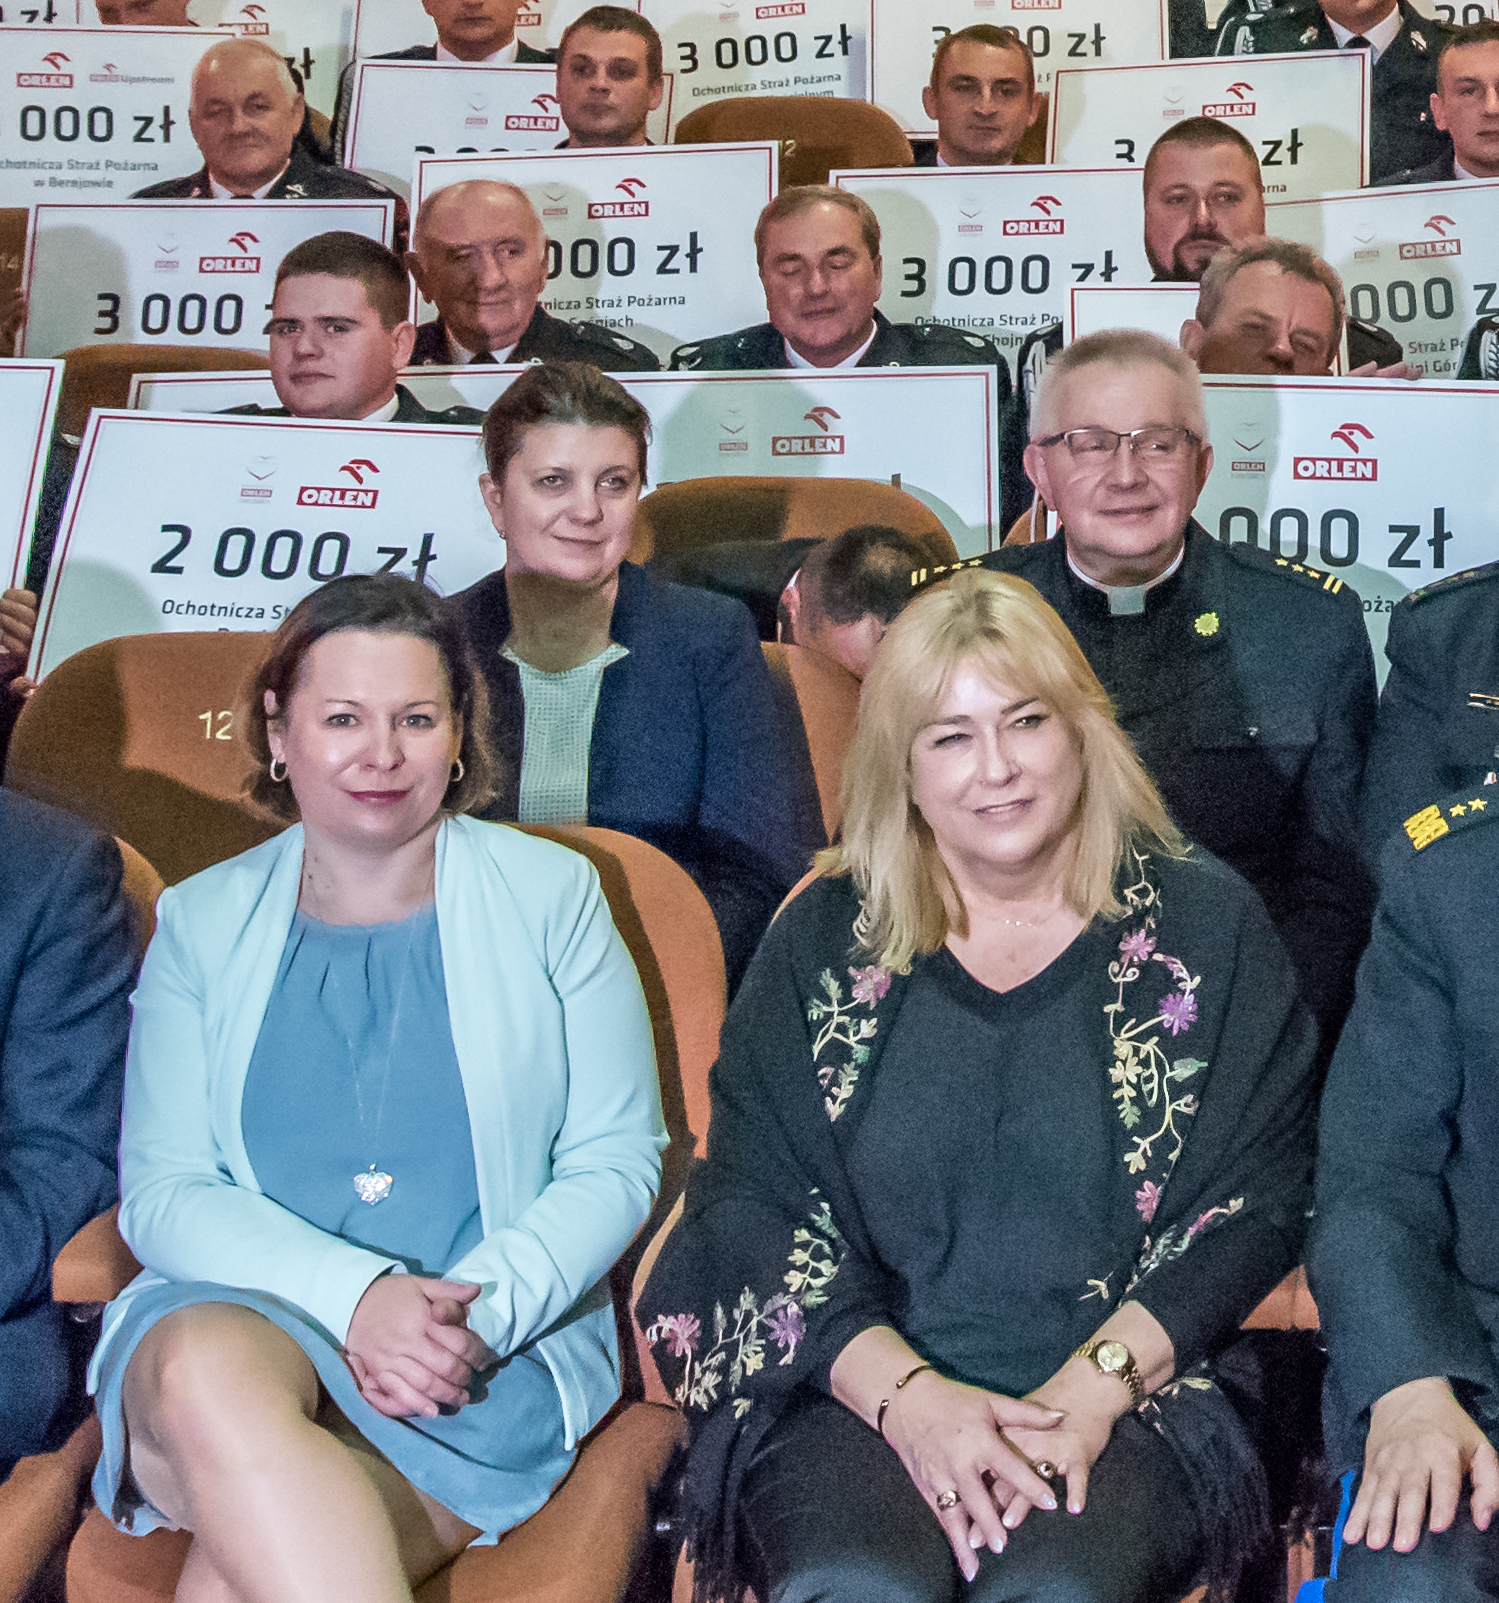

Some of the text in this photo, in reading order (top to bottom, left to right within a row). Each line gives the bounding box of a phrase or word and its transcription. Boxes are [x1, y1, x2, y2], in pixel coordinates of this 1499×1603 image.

[757, 3, 804, 18] ORLEN
[678, 24, 852, 73] 3 000 zł
[18, 74, 73, 86] ORLEN
[21, 105, 113, 142] 000
[133, 106, 176, 142] zł
[67, 159, 101, 170] Straż
[105, 159, 159, 172] Pożarna
[588, 204, 647, 216] ORLEN
[1004, 221, 1062, 234] ORLEN
[201, 258, 258, 271] ORLEN
[657, 232, 703, 274] zł
[901, 251, 1119, 297] 3 000 zł
[94, 293, 243, 335] 3 000
[1295, 460, 1375, 478] ORLEN
[298, 488, 377, 507] ORLEN
[1388, 507, 1453, 568] zł
[151, 525, 351, 582] 2 000
[198, 711, 234, 740] 12
